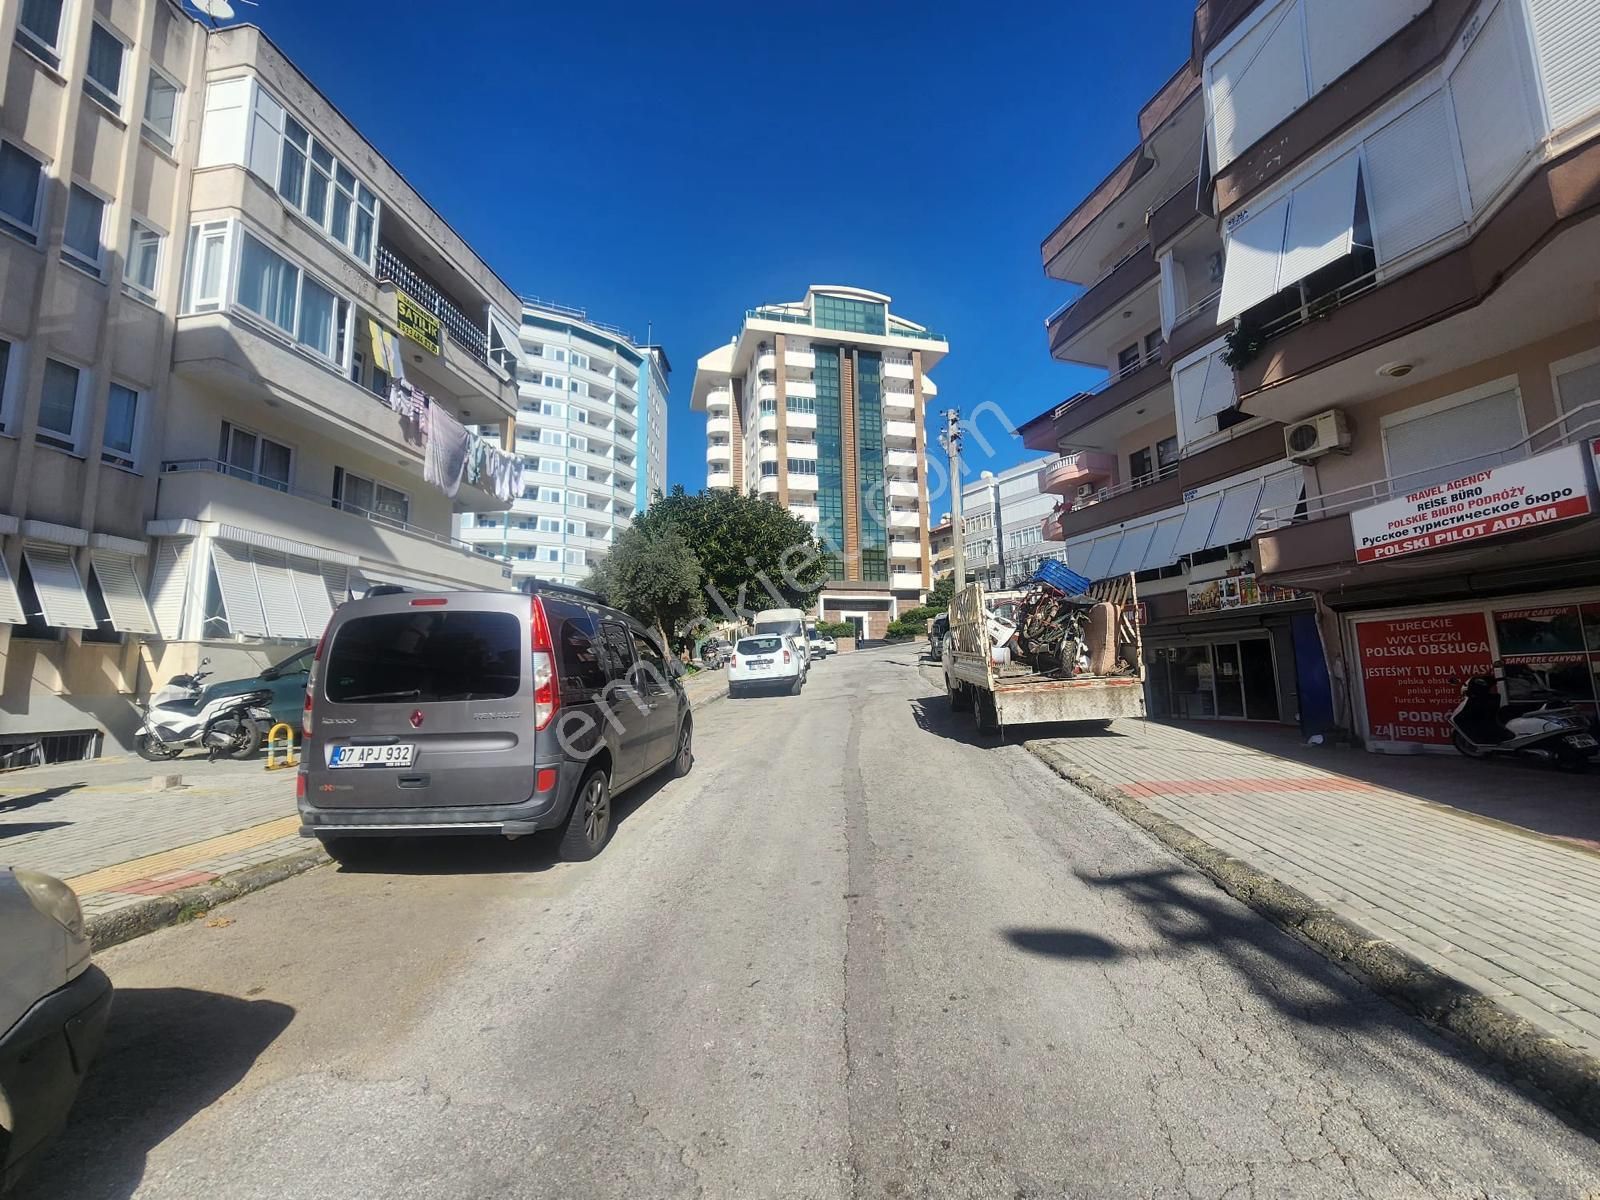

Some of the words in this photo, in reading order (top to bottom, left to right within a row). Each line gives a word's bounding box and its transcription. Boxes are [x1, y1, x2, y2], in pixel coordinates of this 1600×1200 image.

[398, 302, 438, 337] SATILIK
[1406, 486, 1444, 503] TRAVEL
[1446, 470, 1493, 492] AGENCY
[1451, 486, 1483, 502] BÜRO
[1388, 512, 1429, 530] POLSKIE
[1431, 503, 1464, 519] BIURO
[1468, 486, 1525, 509] PODRÓŻY
[1362, 527, 1409, 547] Русское
[1412, 501, 1519, 534] туристическое
[1525, 486, 1573, 507] бюро
[1374, 537, 1430, 558] POLSKI
[1435, 523, 1487, 545] PILOT
[1492, 507, 1558, 532] ADAM
[1531, 607, 1568, 616] CANYON
[1388, 618, 1453, 632] TURECKIE
[1386, 632, 1462, 645] WYCIECZKI
[1366, 646, 1415, 657] POLSKA
[1418, 642, 1489, 655] OBSŁUGA
[1548, 655, 1583, 663] CANYON
[1366, 665, 1411, 679] JESTEŚMY
[1416, 666, 1429, 676] TU
[1434, 665, 1456, 676] DLA
[1395, 725, 1435, 738] JEDEN
[338, 748, 354, 762] 07
[358, 748, 382, 761] APJ
[386, 747, 410, 760] 932
